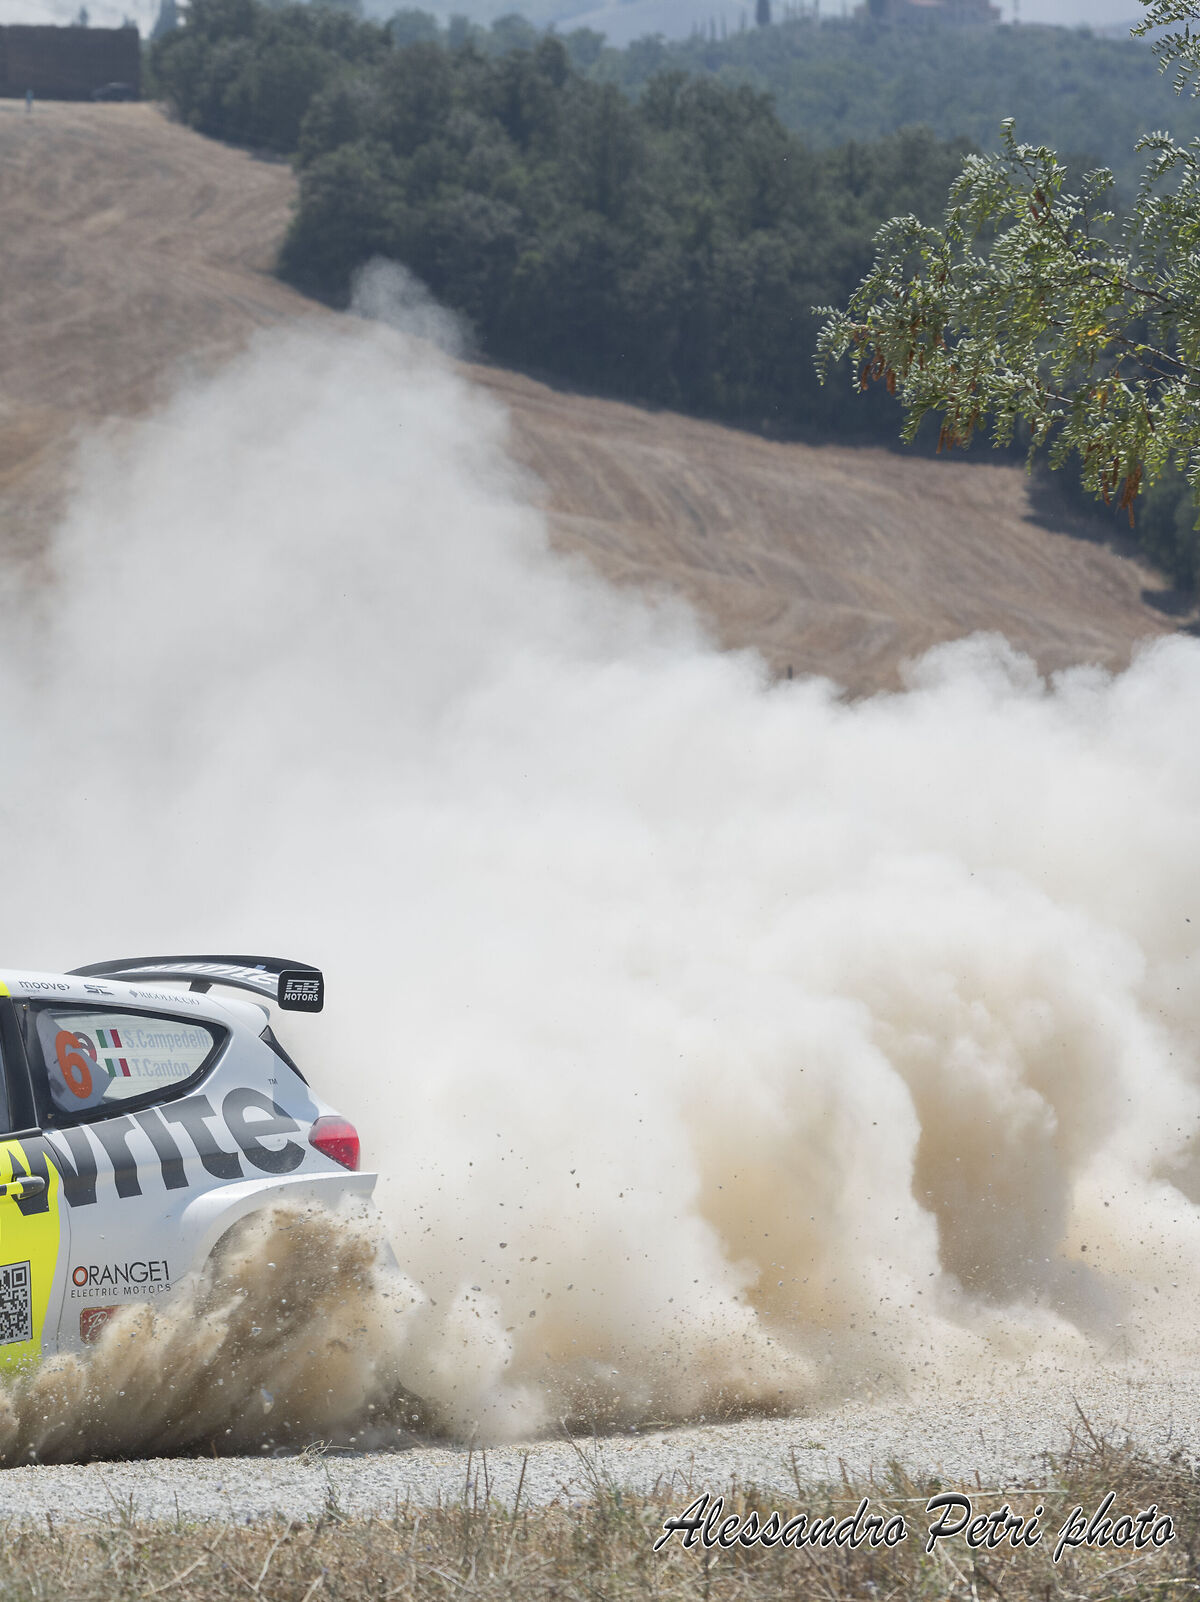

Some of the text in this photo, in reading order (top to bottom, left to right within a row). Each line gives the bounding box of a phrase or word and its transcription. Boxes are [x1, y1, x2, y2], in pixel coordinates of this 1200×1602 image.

[284, 993, 319, 1002] MOTORS
[123, 1028, 211, 1052] S.Campedelli
[55, 1030, 93, 1099] 6
[131, 1058, 191, 1078] T.Canton
[72, 1260, 170, 1287] ORANGE1
[71, 1287, 118, 1299] ELECTRIC
